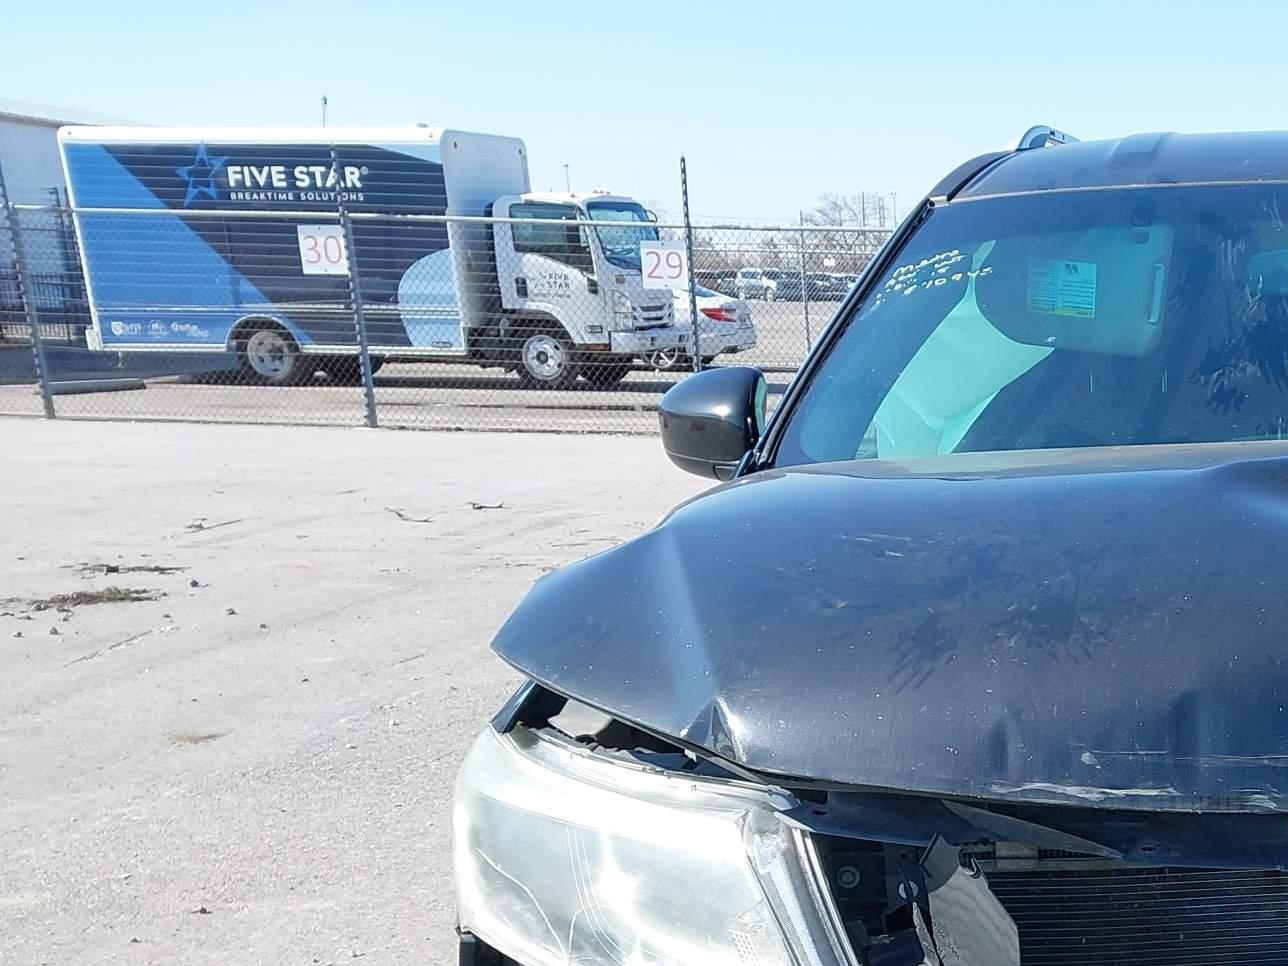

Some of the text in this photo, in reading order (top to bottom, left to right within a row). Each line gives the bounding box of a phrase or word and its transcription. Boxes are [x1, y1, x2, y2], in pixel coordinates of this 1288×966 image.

[227, 165, 363, 188] FIVE STAR
[230, 191, 365, 202] BREAKTIME SOLUTONS
[303, 235, 342, 264] 30
[646, 251, 683, 279] 29
